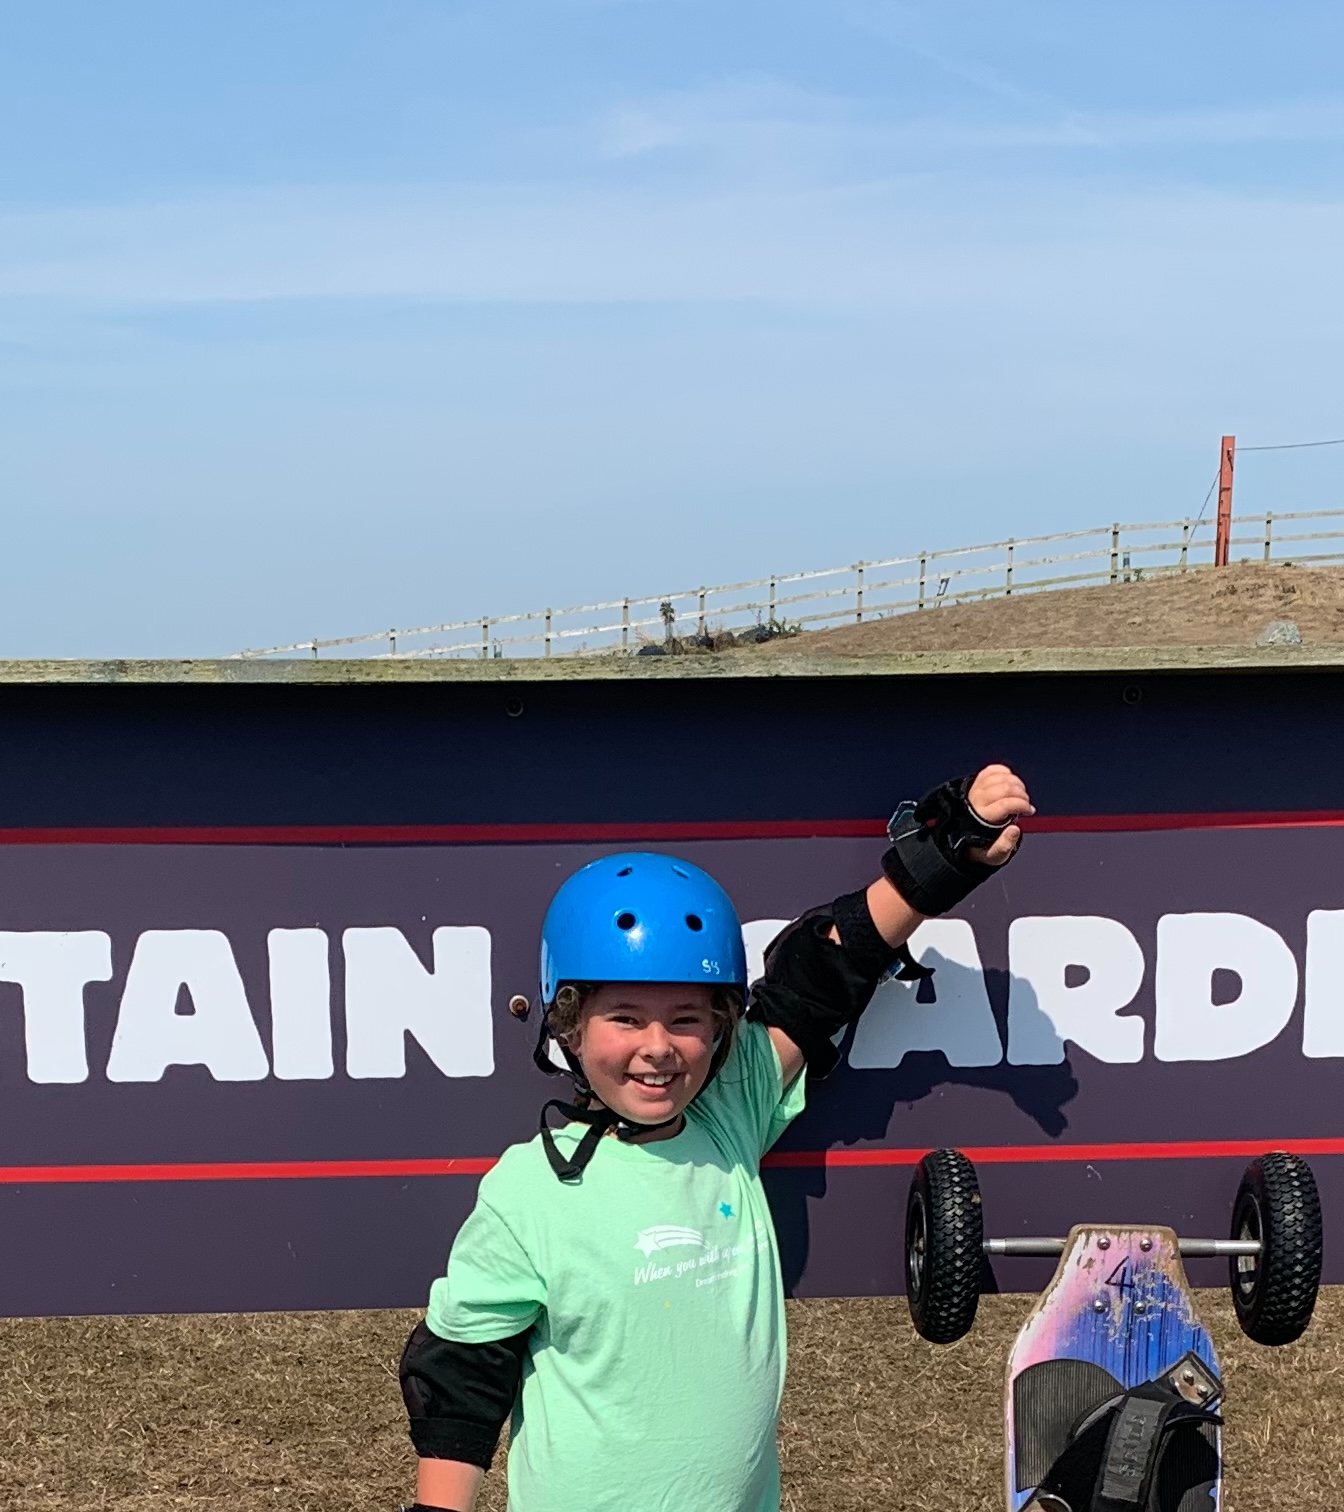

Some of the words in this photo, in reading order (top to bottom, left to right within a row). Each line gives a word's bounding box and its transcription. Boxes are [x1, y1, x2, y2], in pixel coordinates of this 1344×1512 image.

[634, 1261, 672, 1286] When
[675, 1258, 696, 1278] you
[1104, 1255, 1135, 1303] 4
